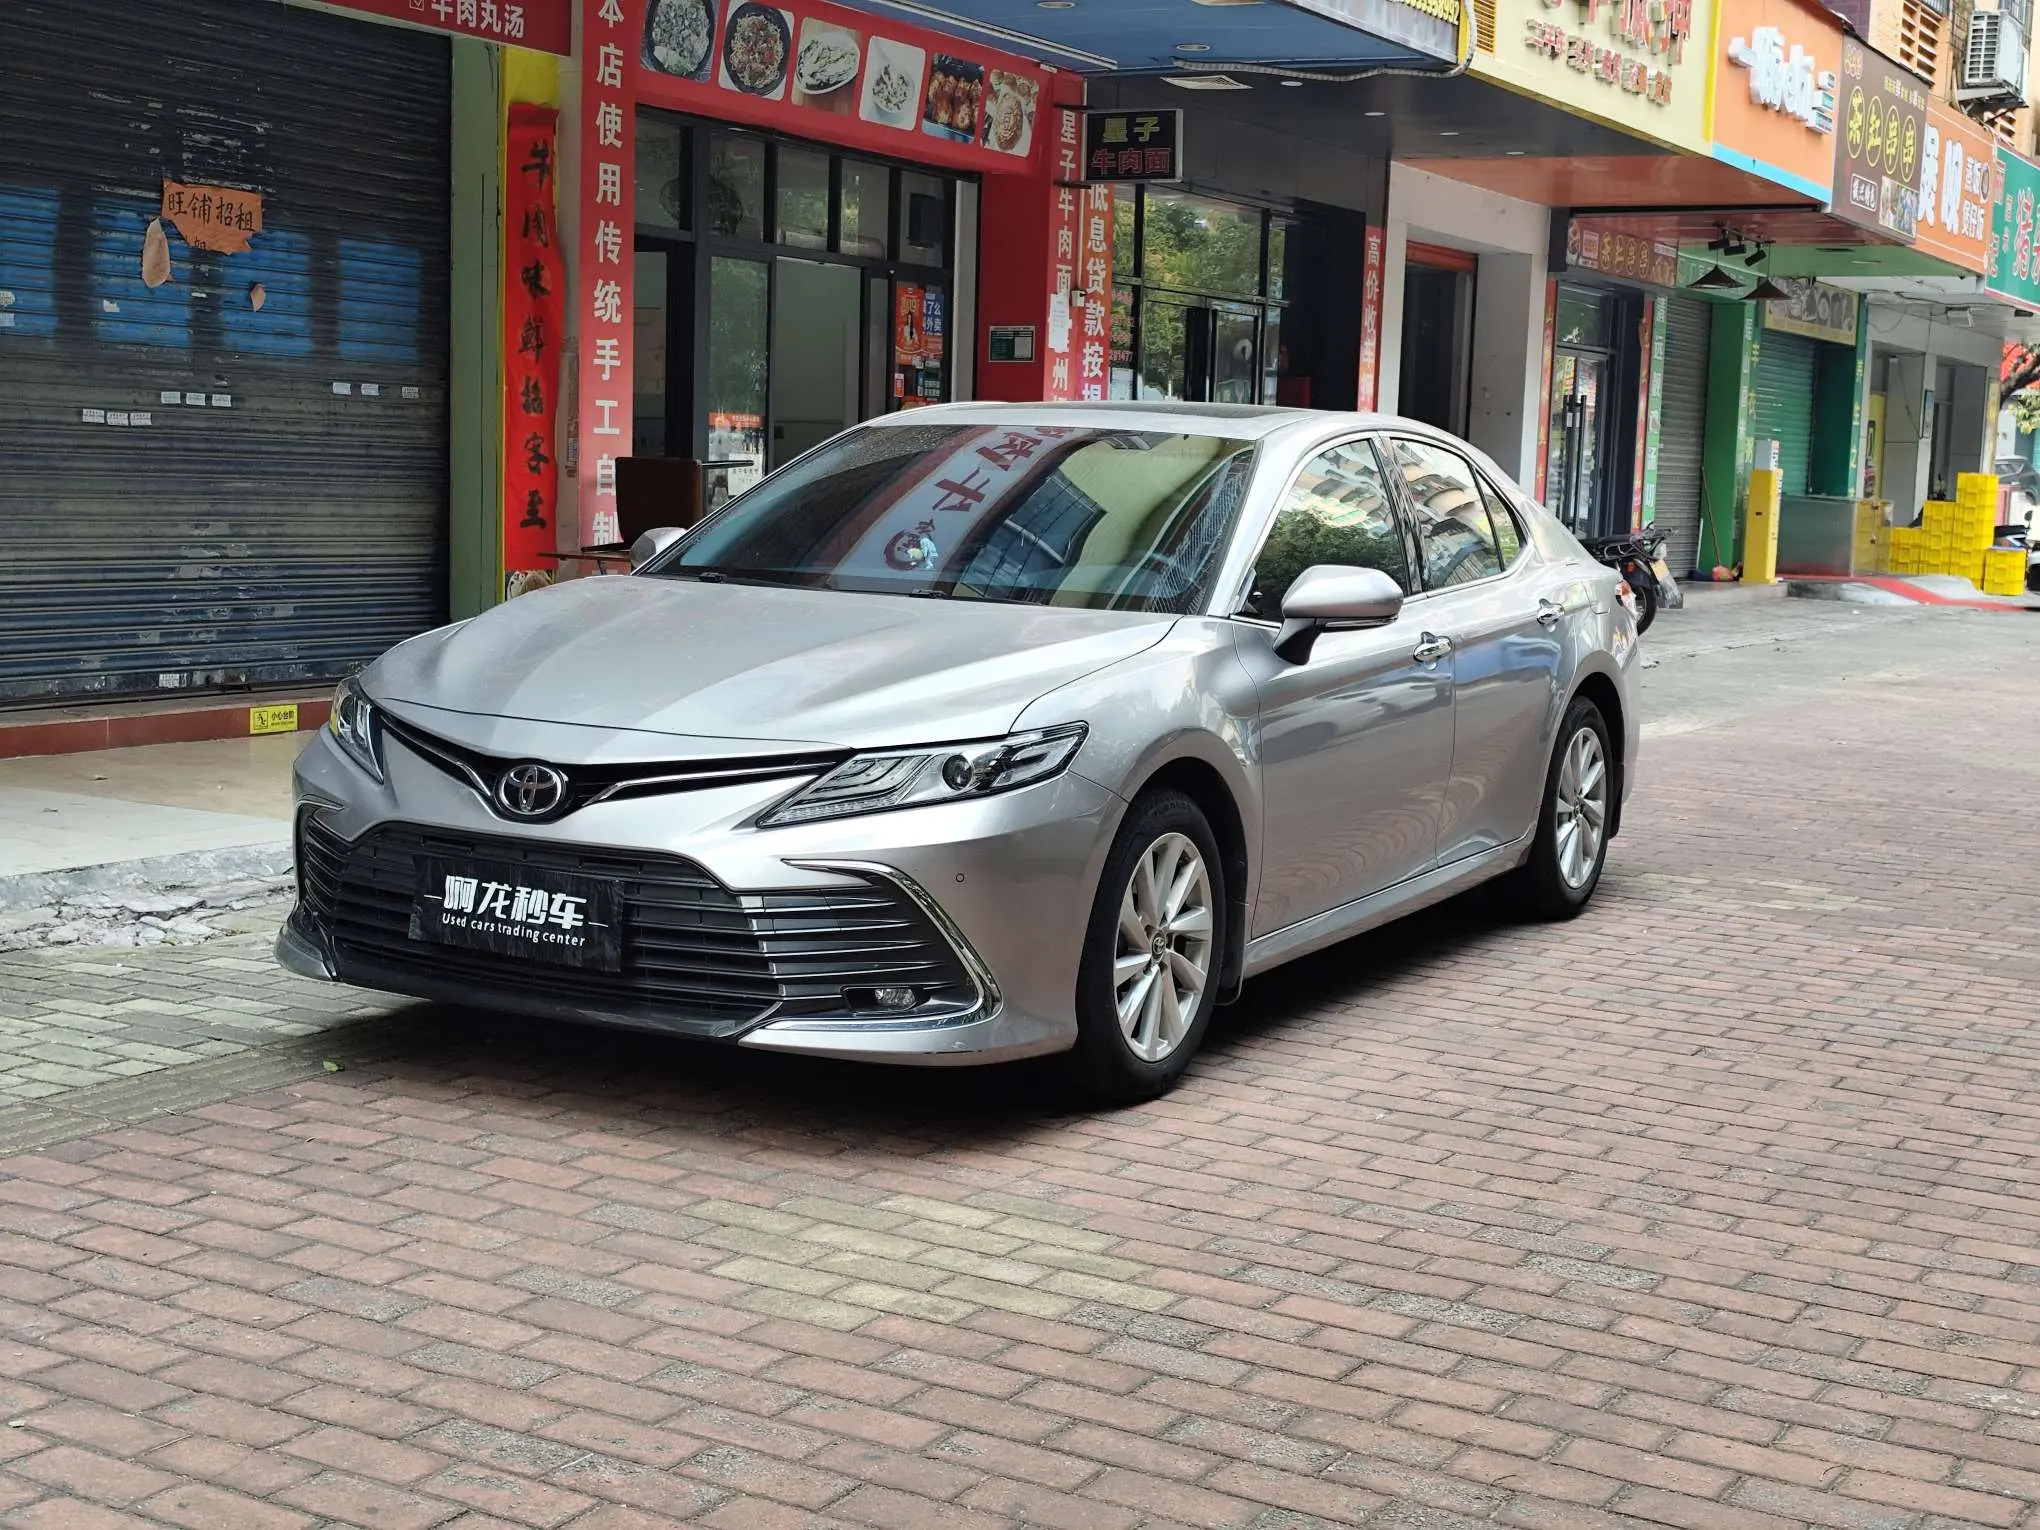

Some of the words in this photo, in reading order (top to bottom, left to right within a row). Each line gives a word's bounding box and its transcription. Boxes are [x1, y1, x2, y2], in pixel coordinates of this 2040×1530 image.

[431, 0, 524, 38] 牛肉丸汤
[1091, 147, 1171, 175] 牛肉面
[168, 191, 256, 232] 旺铺招租
[443, 875, 588, 930] 啊龙秒车
[442, 913, 467, 928] Used
[471, 917, 495, 932] cars
[497, 923, 540, 943] trading
[542, 929, 586, 947] center
